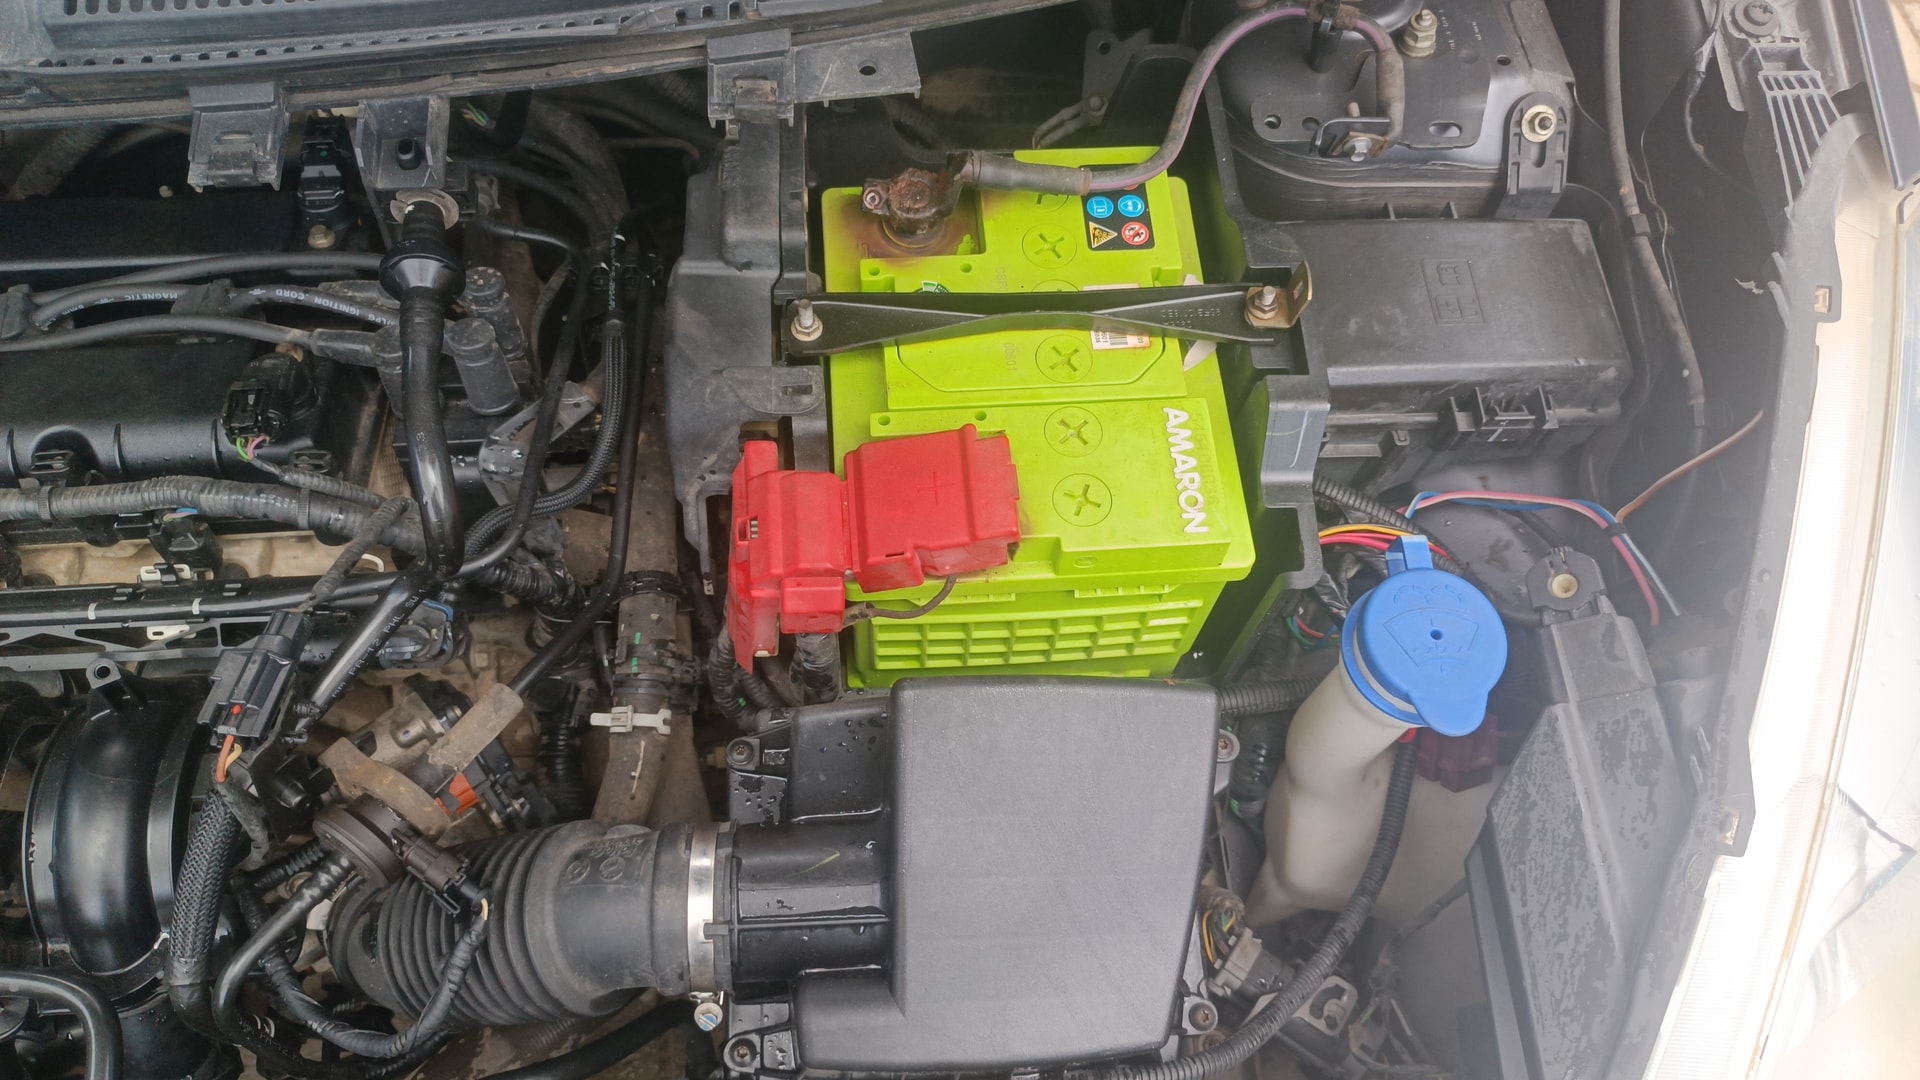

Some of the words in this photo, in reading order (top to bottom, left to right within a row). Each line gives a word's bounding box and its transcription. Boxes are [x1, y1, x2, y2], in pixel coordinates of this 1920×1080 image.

[124, 292, 178, 301] MAGNETIC
[314, 296, 360, 317] IGNITION
[1163, 407, 1210, 533] AMARON
